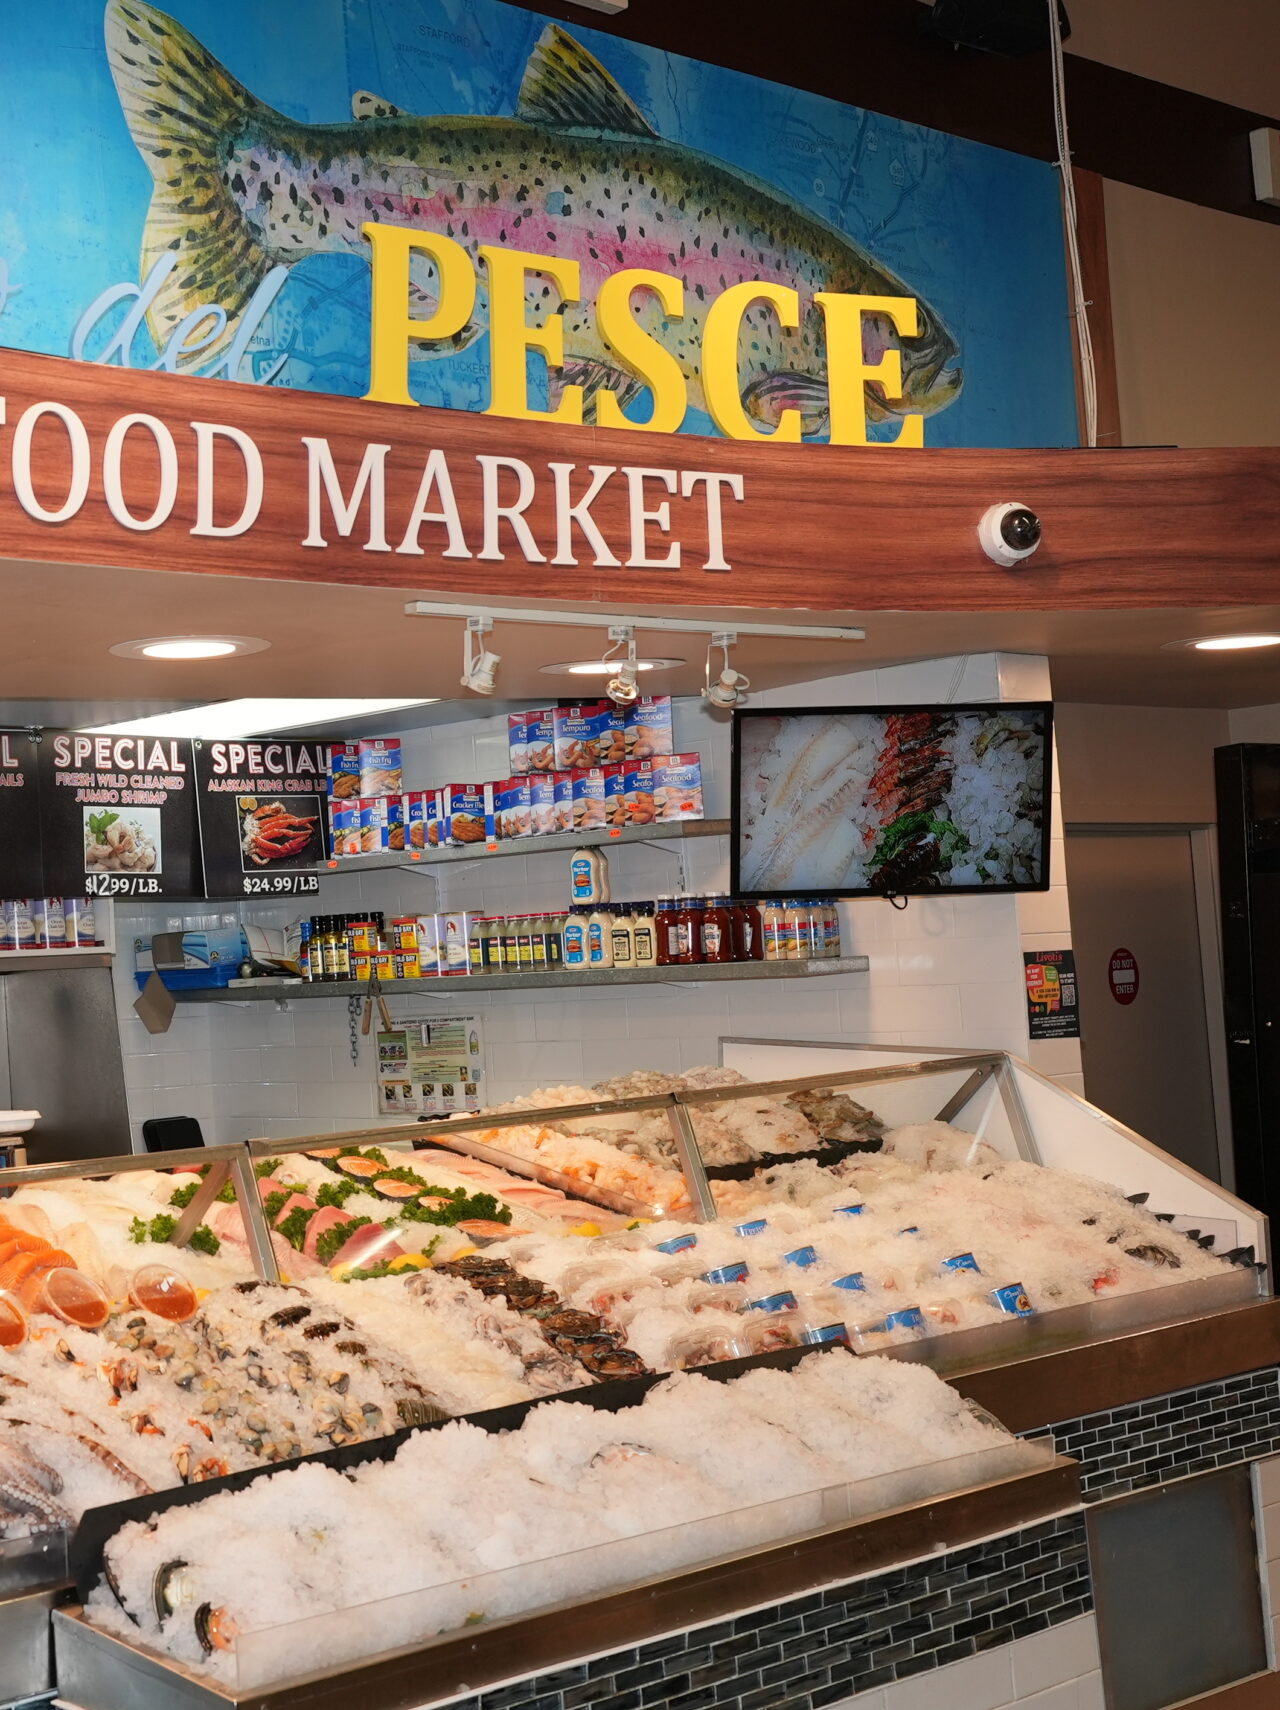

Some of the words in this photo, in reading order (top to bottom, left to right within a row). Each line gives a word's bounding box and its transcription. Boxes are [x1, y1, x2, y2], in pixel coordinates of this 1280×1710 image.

[68, 250, 290, 386] del
[361, 221, 925, 449] PESCE
[250, 334, 271, 347] etna
[300, 435, 745, 572] MARKET
[53, 735, 186, 772] SPECIAL
[211, 743, 327, 775] SPECIAL
[55, 772, 95, 787] FRESH
[96, 773, 129, 789] WILD
[130, 774, 185, 790] CLEANED
[208, 779, 256, 792] ALASKAN
[257, 780, 284, 792] KING
[285, 780, 313, 792] CRAB
[661, 773, 692, 783] Seafood
[75, 788, 119, 803] JUMBO
[121, 789, 168, 805] SHRIMP
[1113, 960, 1120, 969] DO
[1122, 959, 1133, 968] NOT
[1116, 985, 1134, 994] ENTER
